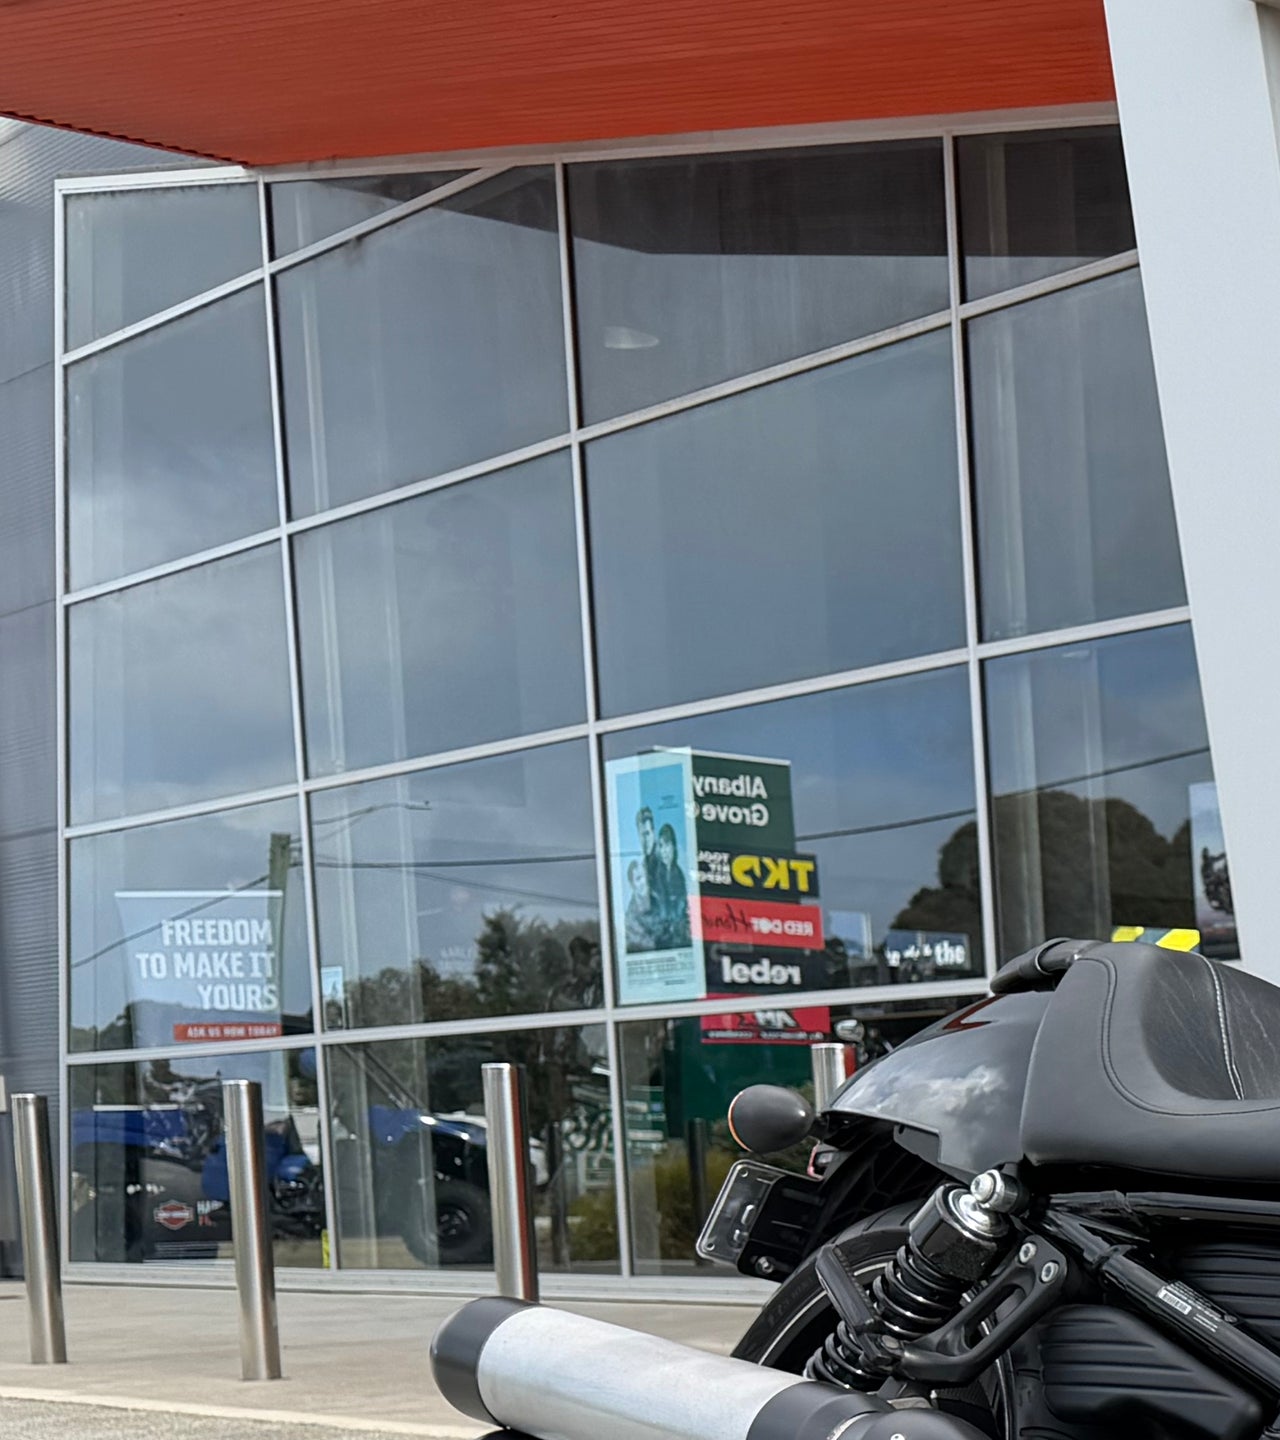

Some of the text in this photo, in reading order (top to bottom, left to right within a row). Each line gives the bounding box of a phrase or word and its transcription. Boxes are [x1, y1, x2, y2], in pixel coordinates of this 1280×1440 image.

[161, 919, 273, 947] FREEDOM
[135, 952, 276, 979] TO MAKE IT
[197, 984, 279, 1011] YOURS
